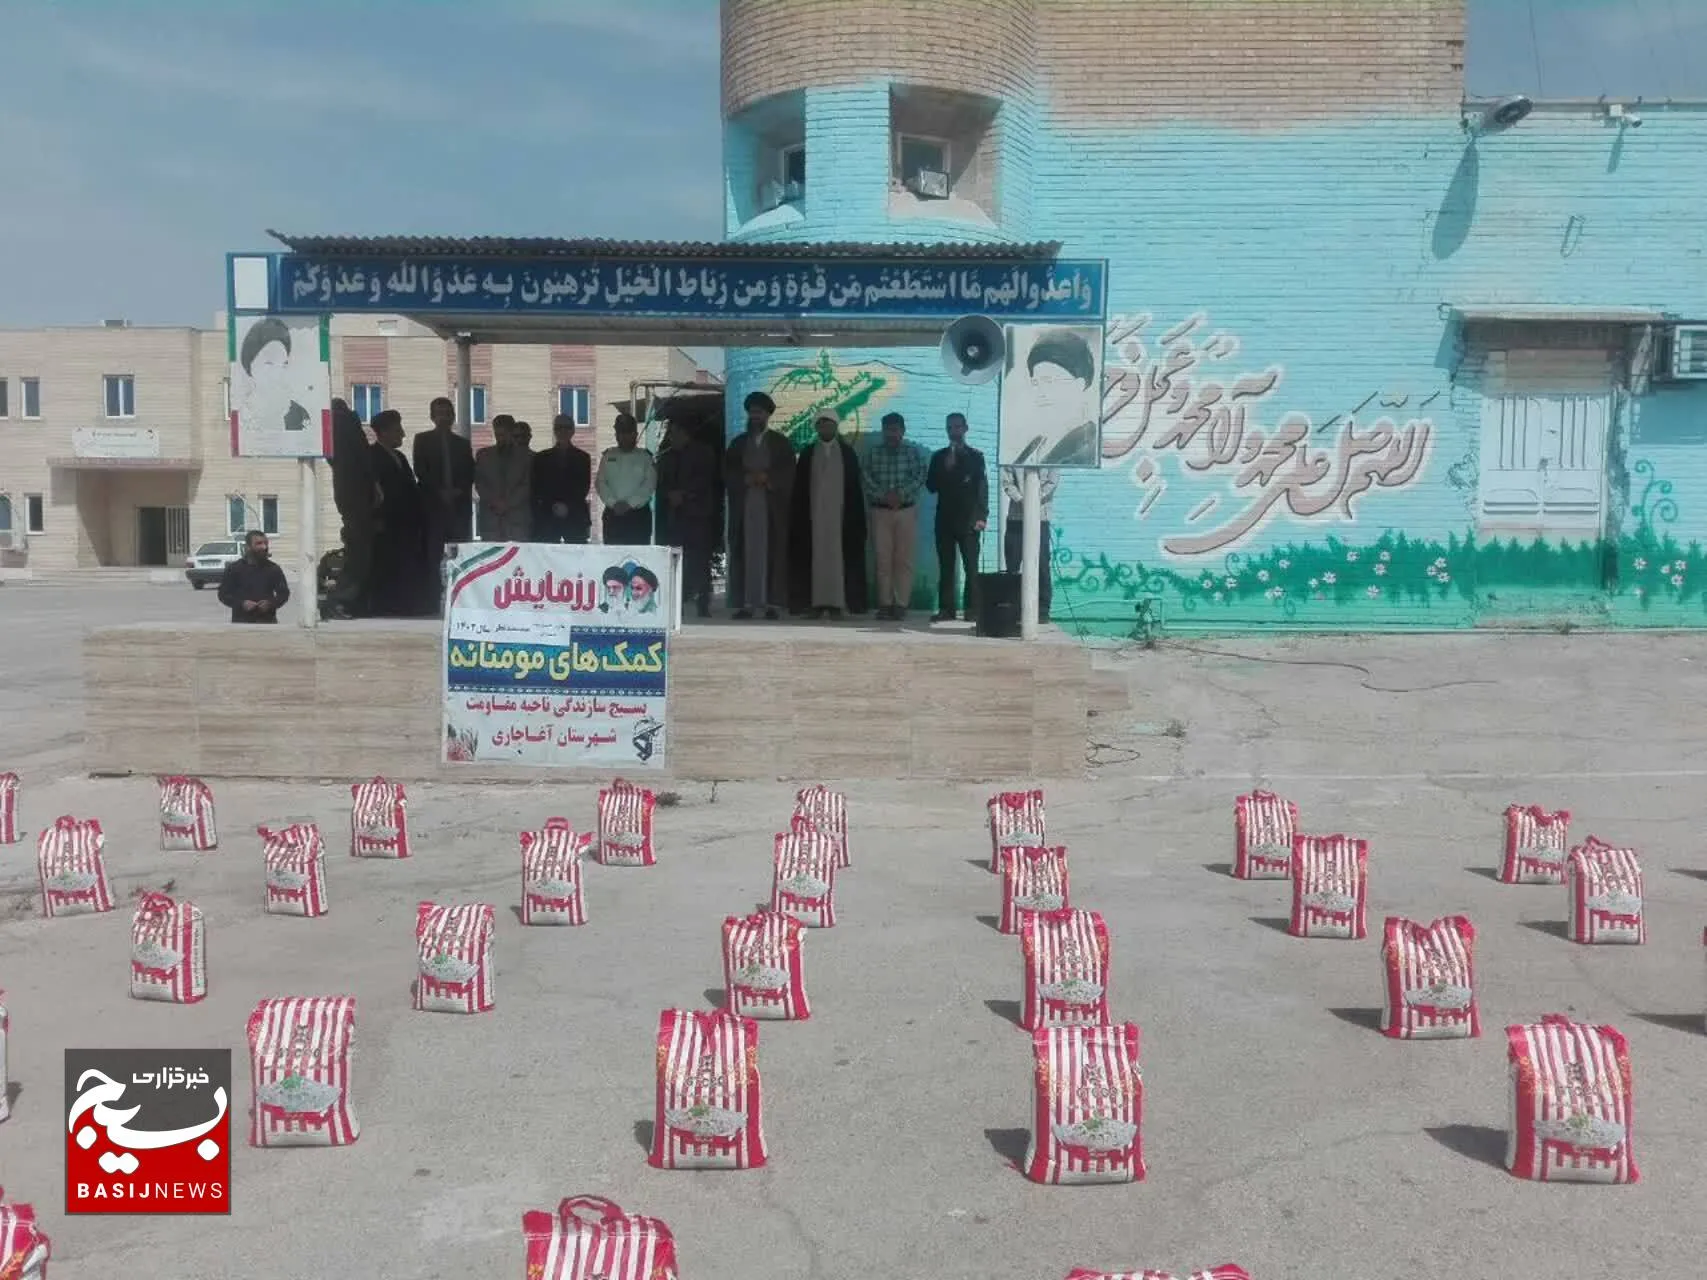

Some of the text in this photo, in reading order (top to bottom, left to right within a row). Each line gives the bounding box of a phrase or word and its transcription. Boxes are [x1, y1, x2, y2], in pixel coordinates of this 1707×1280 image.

[493, 564, 597, 612] رزمایش
[450, 641, 663, 681] کمک های مومنانه
[465, 695, 648, 718] بسیج سازندگی ناحیه مقاومت
[491, 723, 617, 748] شهرستان آغاجاری
